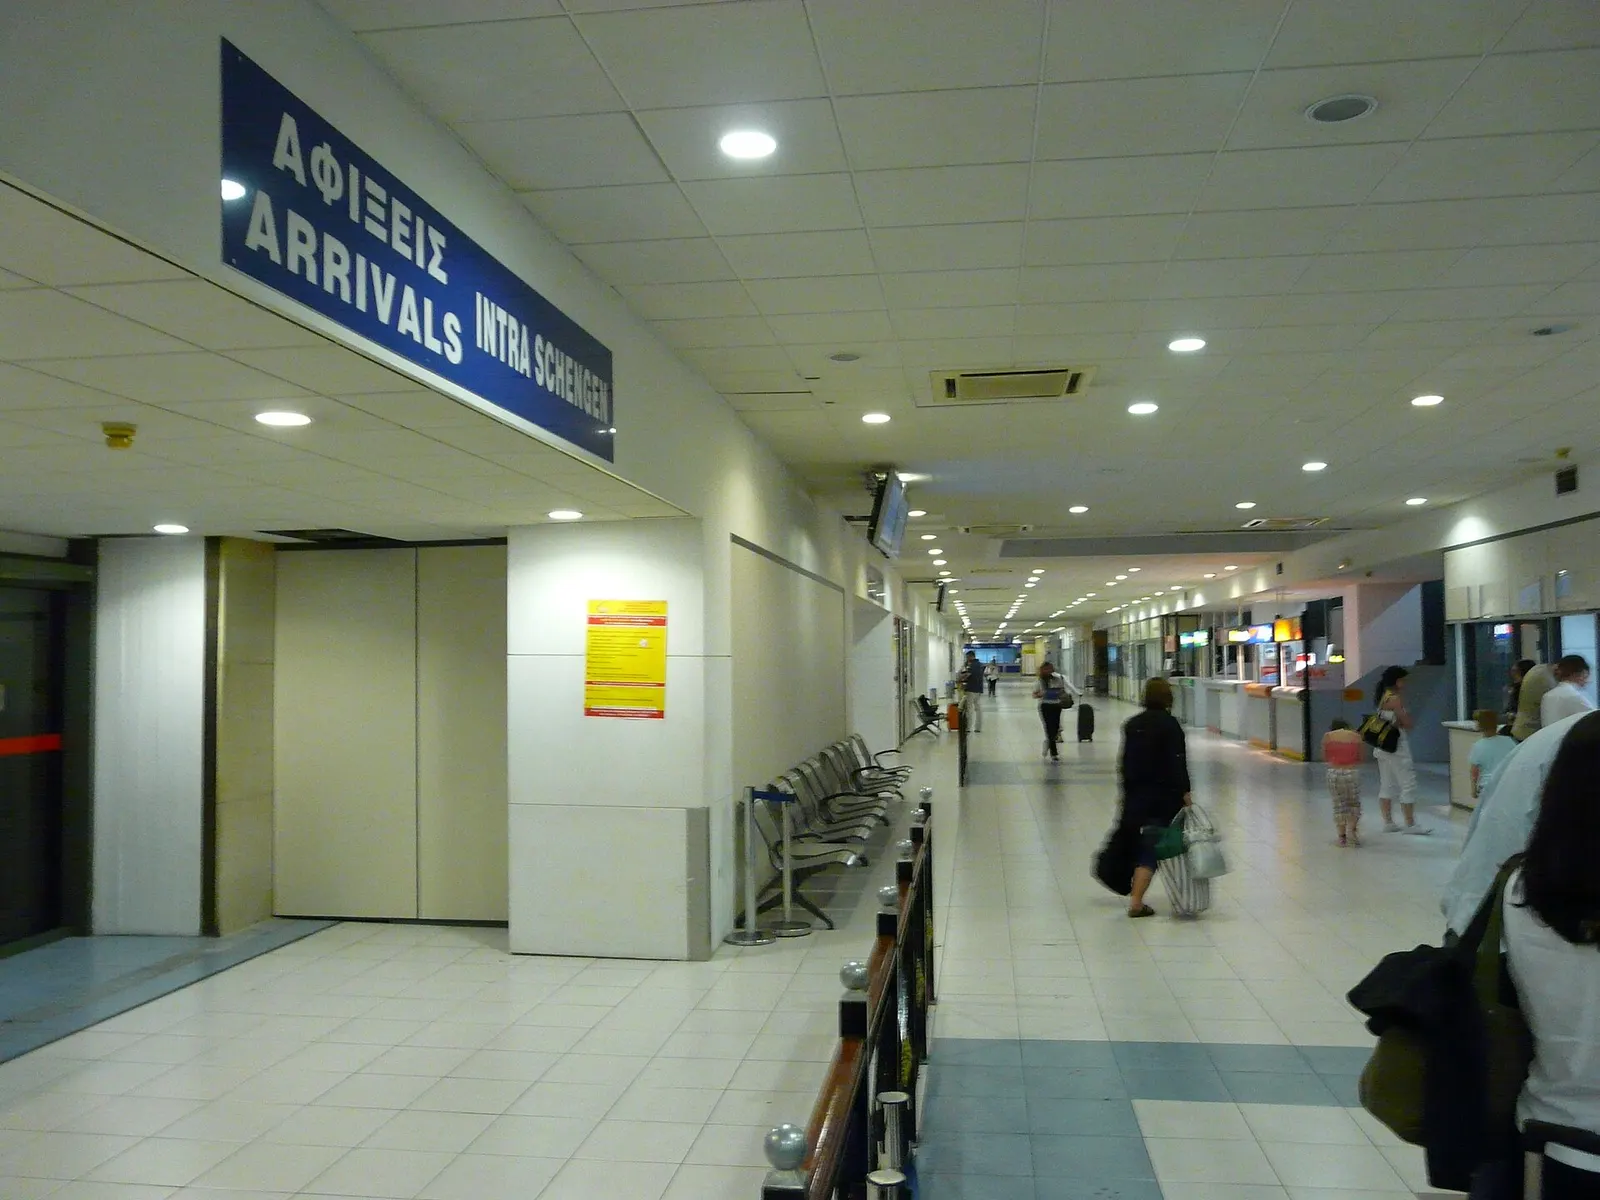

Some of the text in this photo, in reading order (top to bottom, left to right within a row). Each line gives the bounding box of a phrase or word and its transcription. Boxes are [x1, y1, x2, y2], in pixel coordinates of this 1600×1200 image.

[245, 190, 464, 365] ARRIVALS
[272, 112, 449, 286] ΑΦΙΞΕΙΣ
[475, 291, 609, 424] INTRA SCHENGEN
